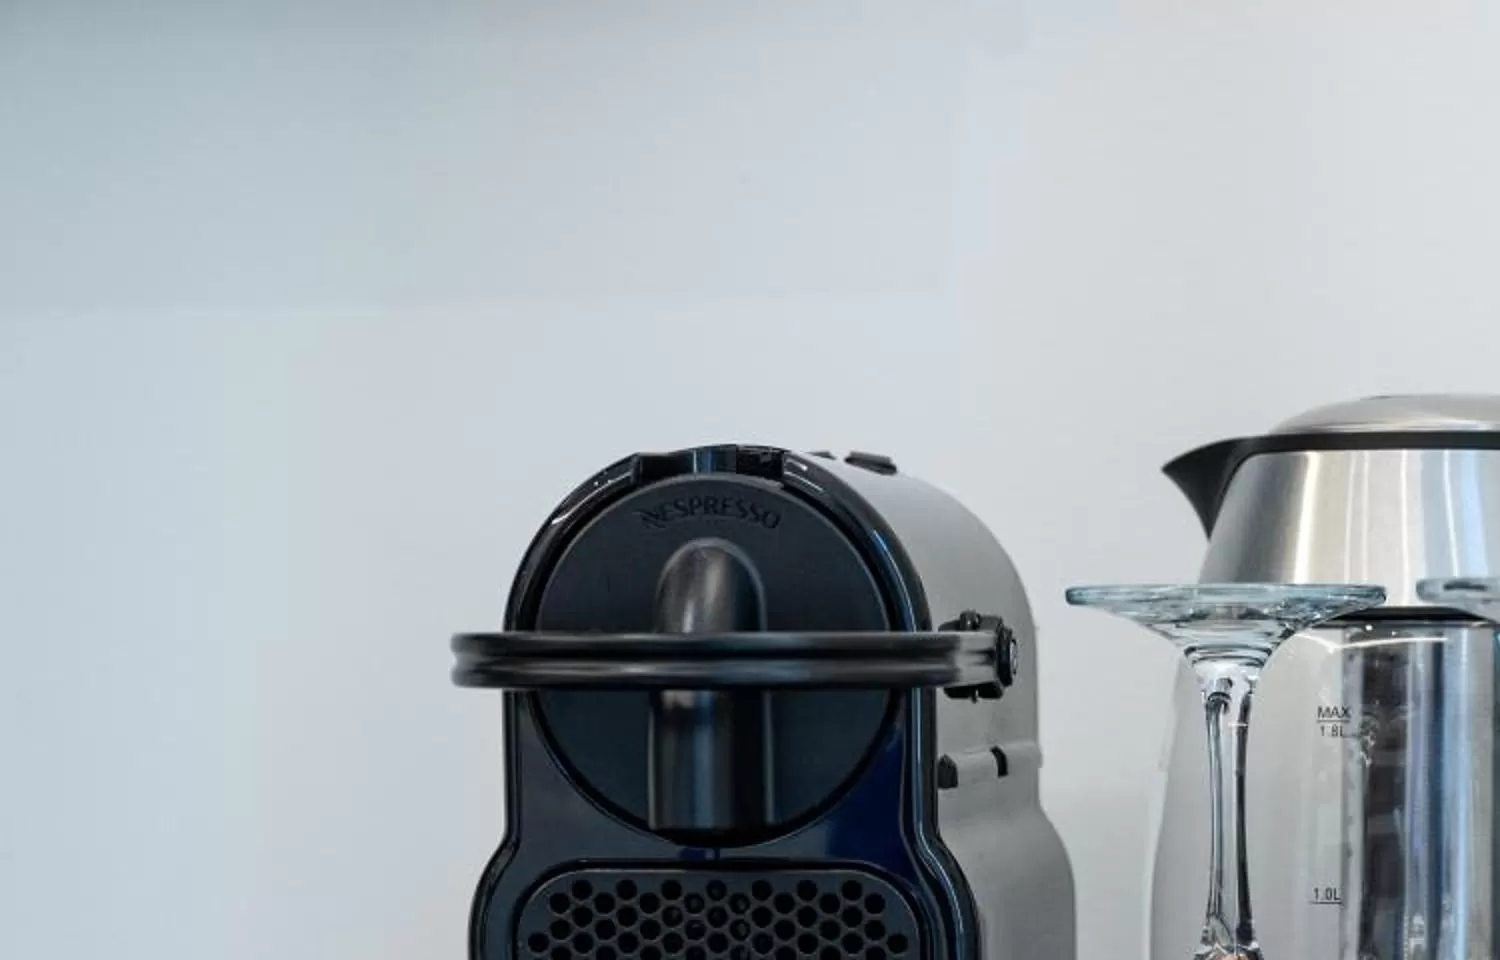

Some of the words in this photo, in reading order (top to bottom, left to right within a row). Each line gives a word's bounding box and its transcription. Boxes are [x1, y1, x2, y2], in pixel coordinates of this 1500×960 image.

[635, 494, 782, 529] NESPRESSO
[1317, 705, 1352, 719] MAX
[1312, 887, 1341, 901] 1.0L
